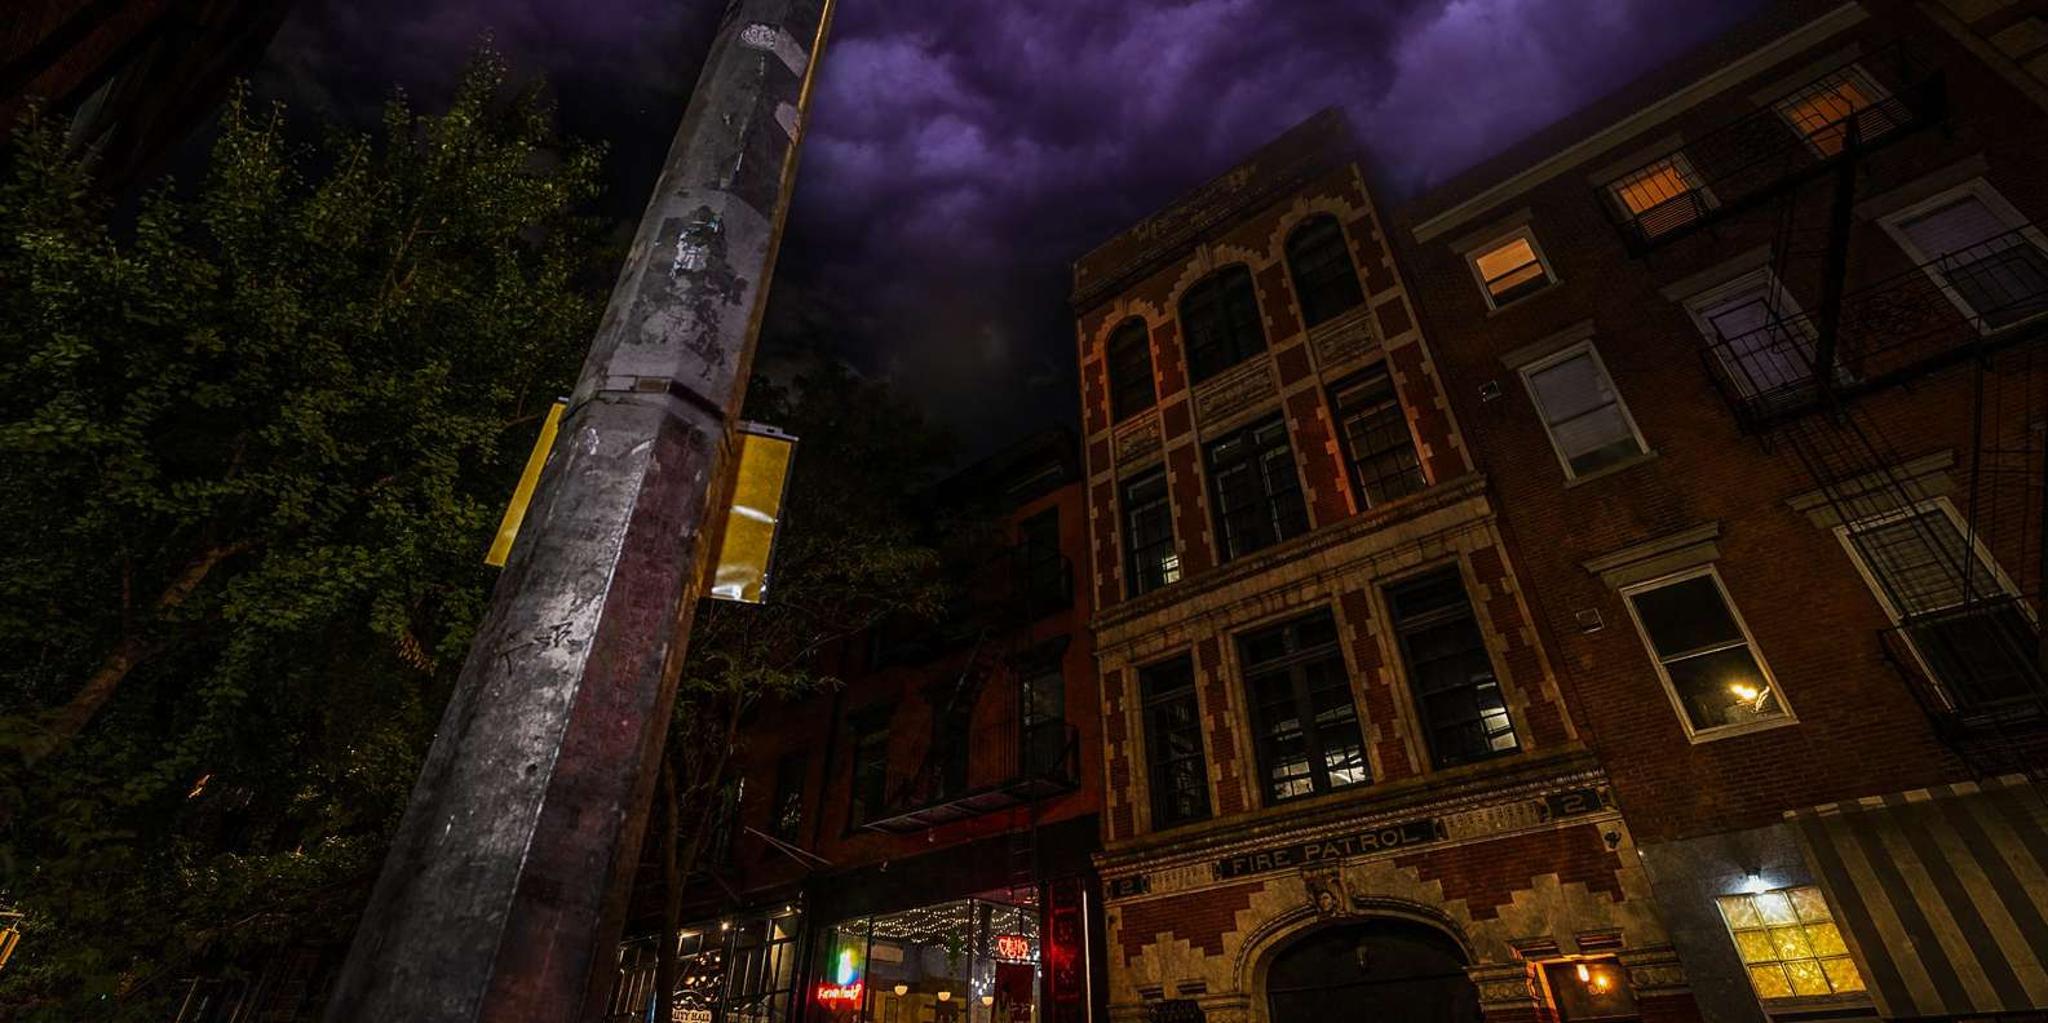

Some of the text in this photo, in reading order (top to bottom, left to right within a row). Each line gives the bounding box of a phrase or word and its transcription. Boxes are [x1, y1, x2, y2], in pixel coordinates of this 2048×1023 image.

[1561, 793, 1585, 814] 2
[1231, 827, 1421, 875] FIRE PATROL
